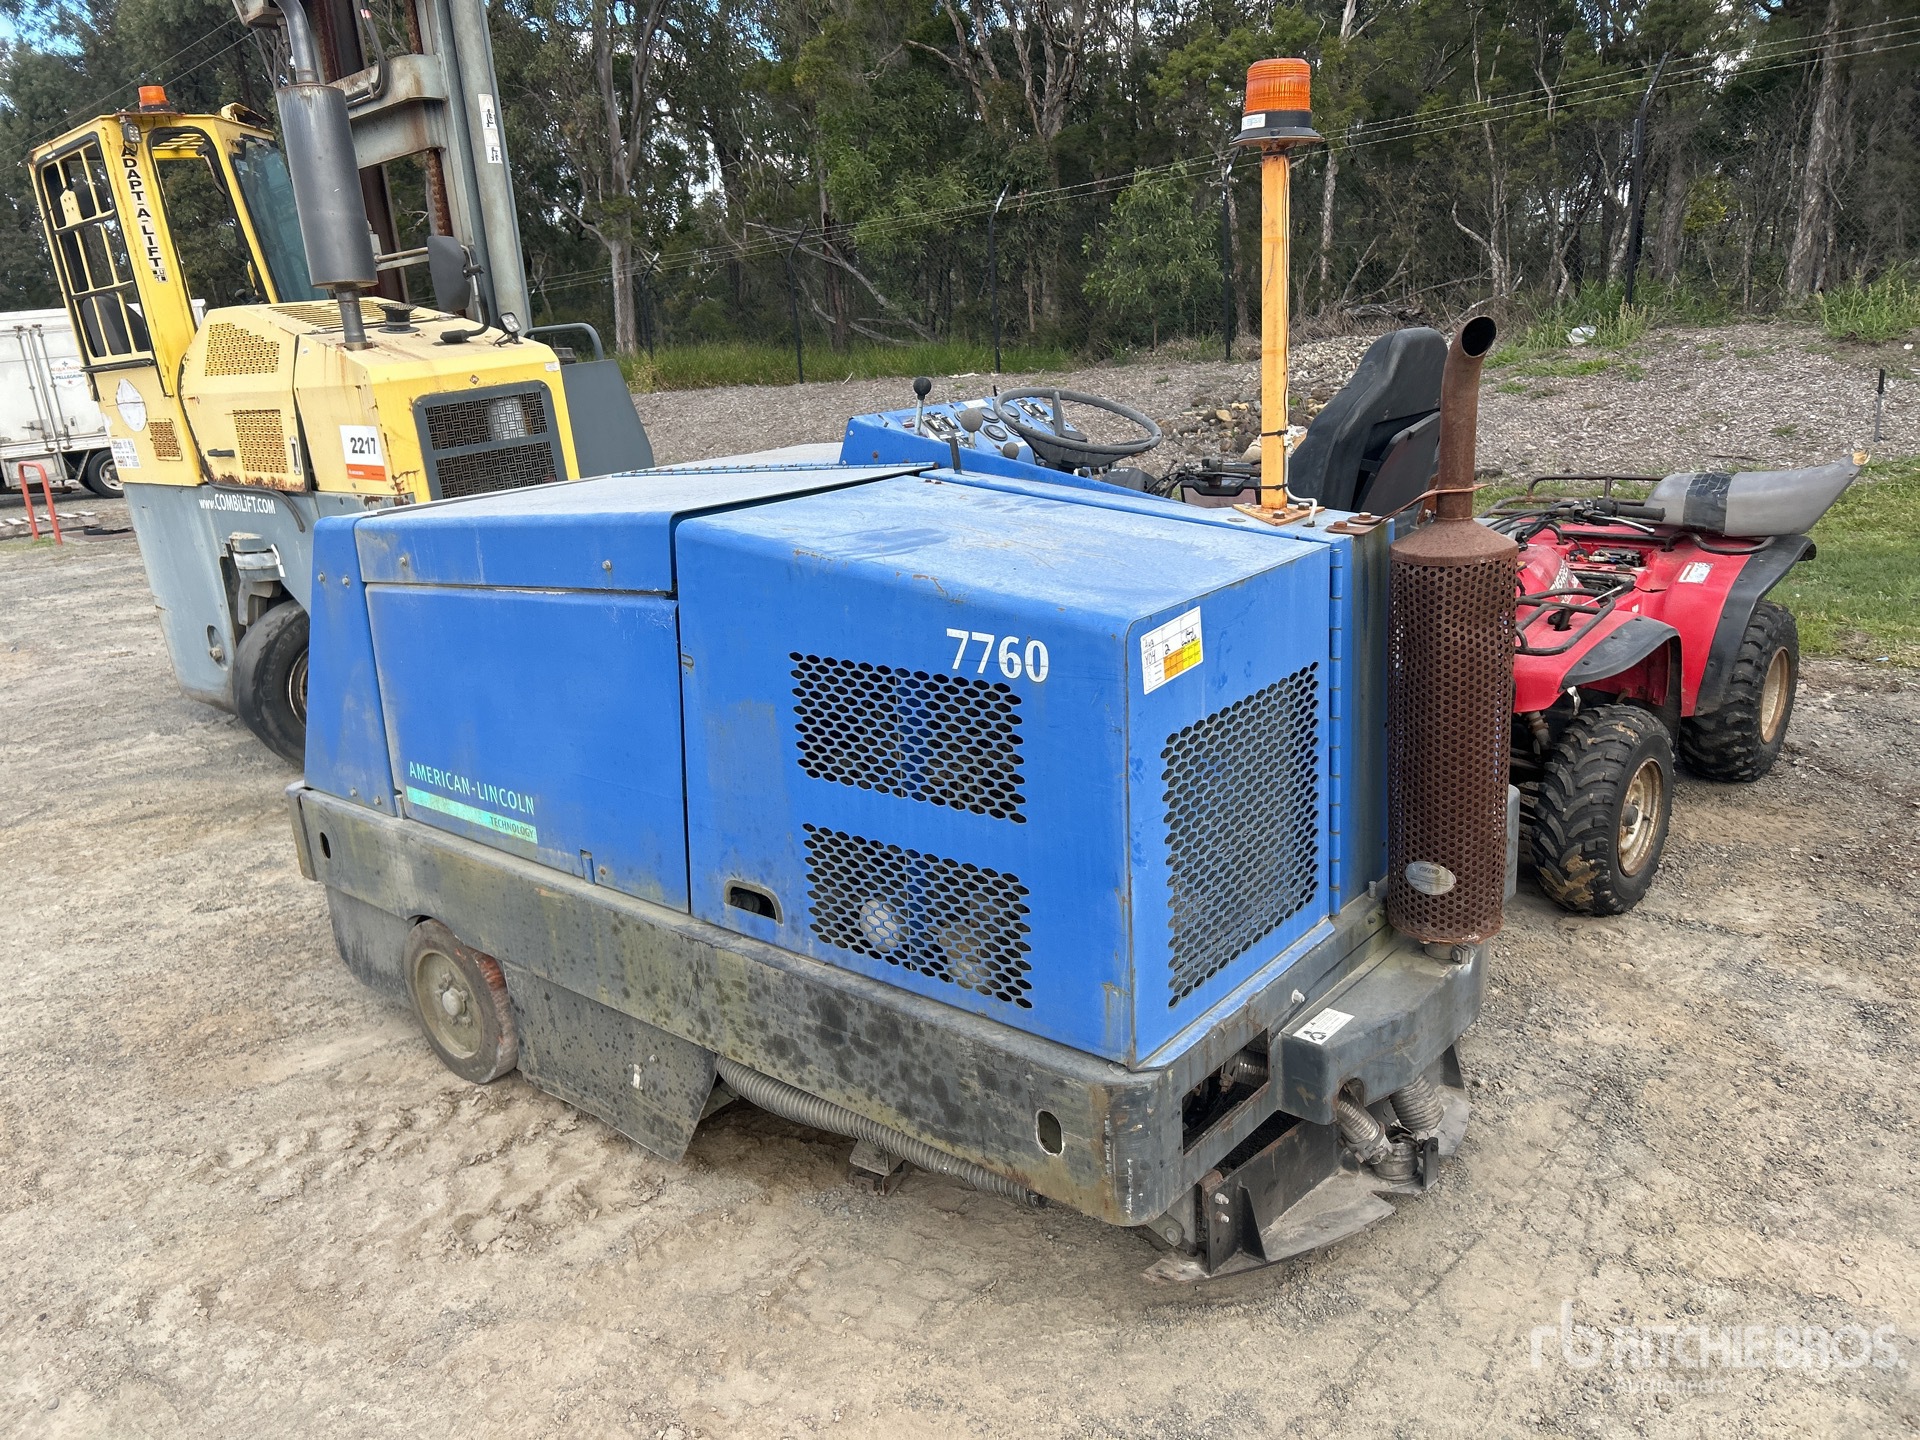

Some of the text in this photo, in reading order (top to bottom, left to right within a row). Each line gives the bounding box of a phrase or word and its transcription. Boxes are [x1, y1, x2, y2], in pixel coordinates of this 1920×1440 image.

[121, 143, 163, 268] ADAPT-A-LIFT
[350, 437, 376, 455] 2217
[946, 628, 1049, 683] 7760
[409, 761, 535, 815] AMERICAN-LINCOLN
[489, 816, 534, 838] TECHNOLOGY
